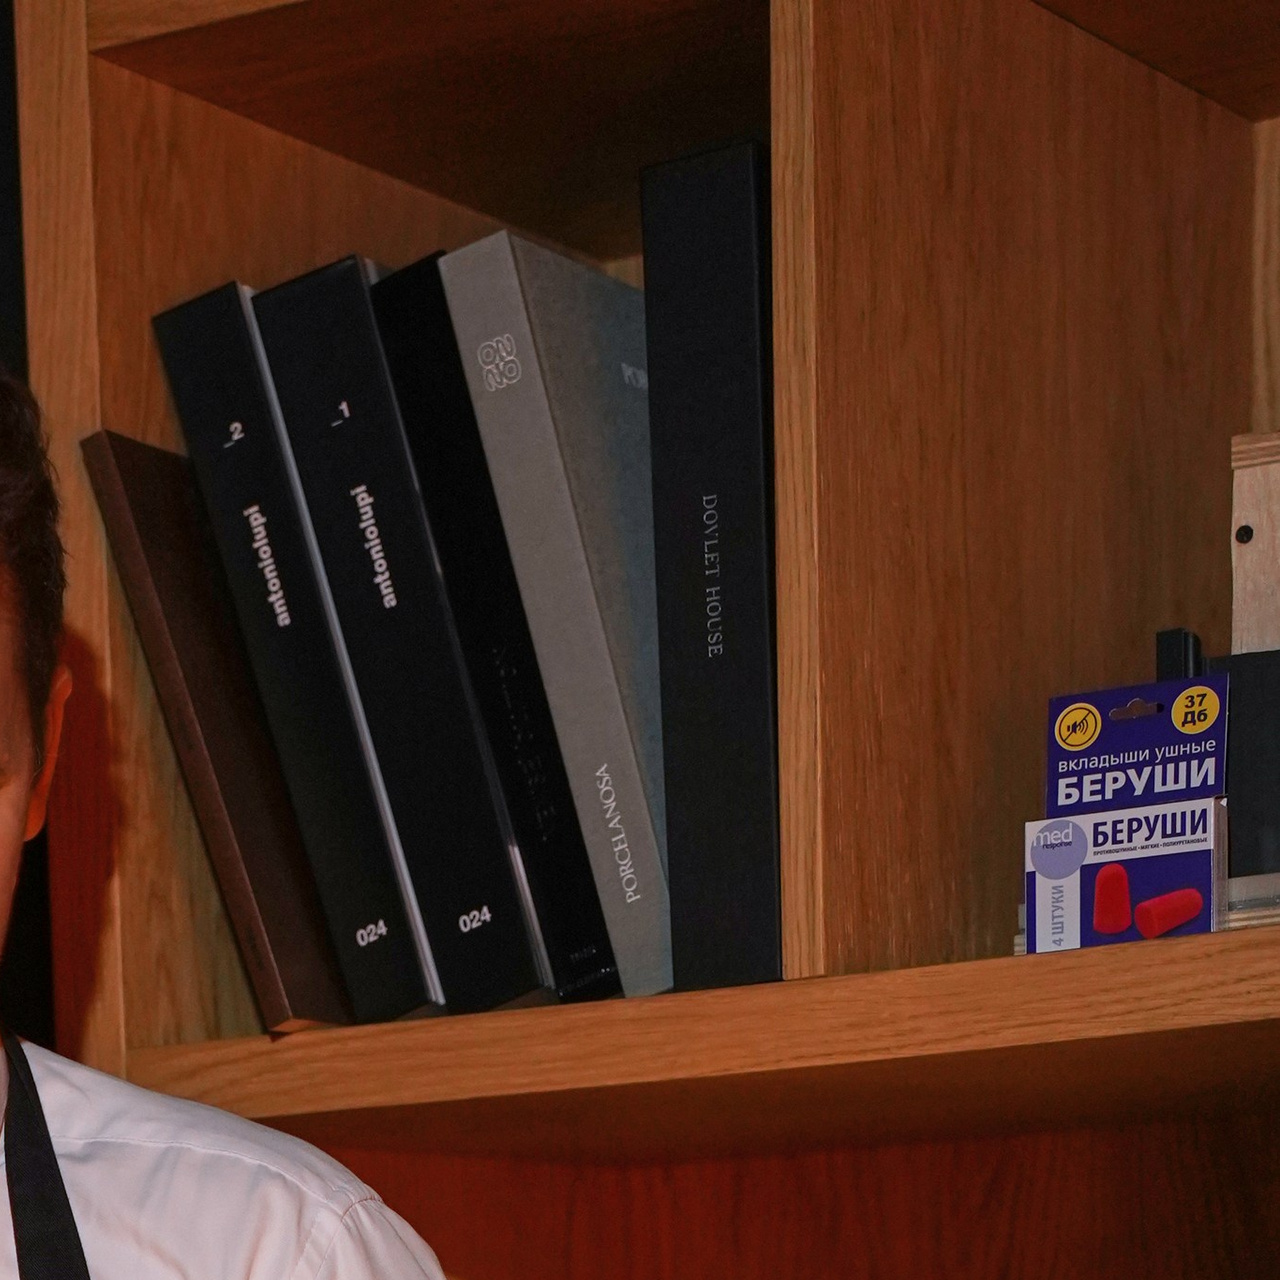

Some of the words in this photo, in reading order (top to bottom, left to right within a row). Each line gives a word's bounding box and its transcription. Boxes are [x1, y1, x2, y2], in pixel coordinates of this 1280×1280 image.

[350, 485, 398, 609] antoniolupi
[702, 494, 721, 578] DOVLET
[243, 504, 292, 627] antoniolupi
[706, 586, 724, 658] HOUSE
[1181, 709, 1208, 728] Дб
[1184, 693, 1207, 709] 37
[1058, 749, 1149, 773] вкладыши
[1154, 739, 1216, 764] ушные
[1057, 757, 1216, 806] БЕРУШИ
[594, 763, 641, 904] PORCELANOSA
[1033, 822, 1073, 847] med
[1092, 808, 1208, 848] БЕРУШИ
[459, 905, 492, 933] 024
[1051, 885, 1064, 935] ШТУКИ
[356, 919, 388, 947] 024
[1052, 937, 1064, 947] 4
